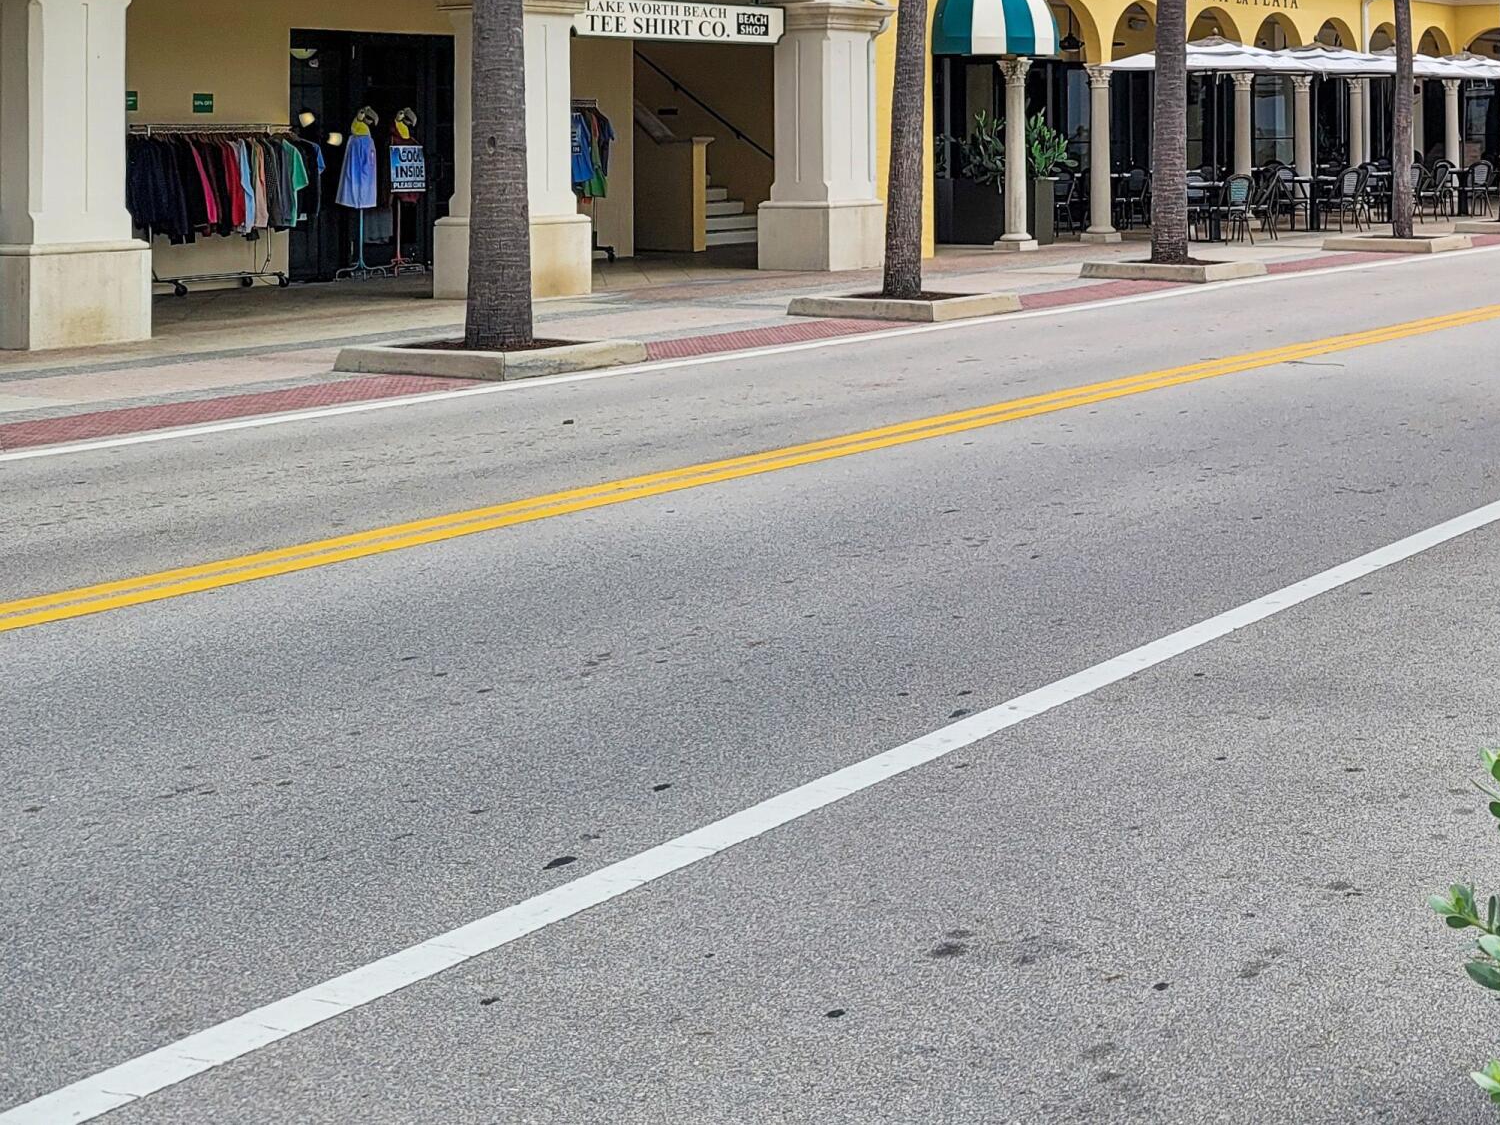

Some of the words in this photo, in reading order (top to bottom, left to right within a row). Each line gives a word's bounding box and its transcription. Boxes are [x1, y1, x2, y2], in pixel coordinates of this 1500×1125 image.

[586, 0, 625, 14] LAKE
[629, 2, 680, 17] WORTH
[683, 6, 727, 19] BEACH
[738, 13, 767, 25] BEACH
[586, 15, 627, 32] TEE
[632, 18, 693, 36] SHIRT
[698, 20, 731, 38] CO.
[740, 25, 766, 35] SHOP
[396, 166, 424, 178] INSIDE
